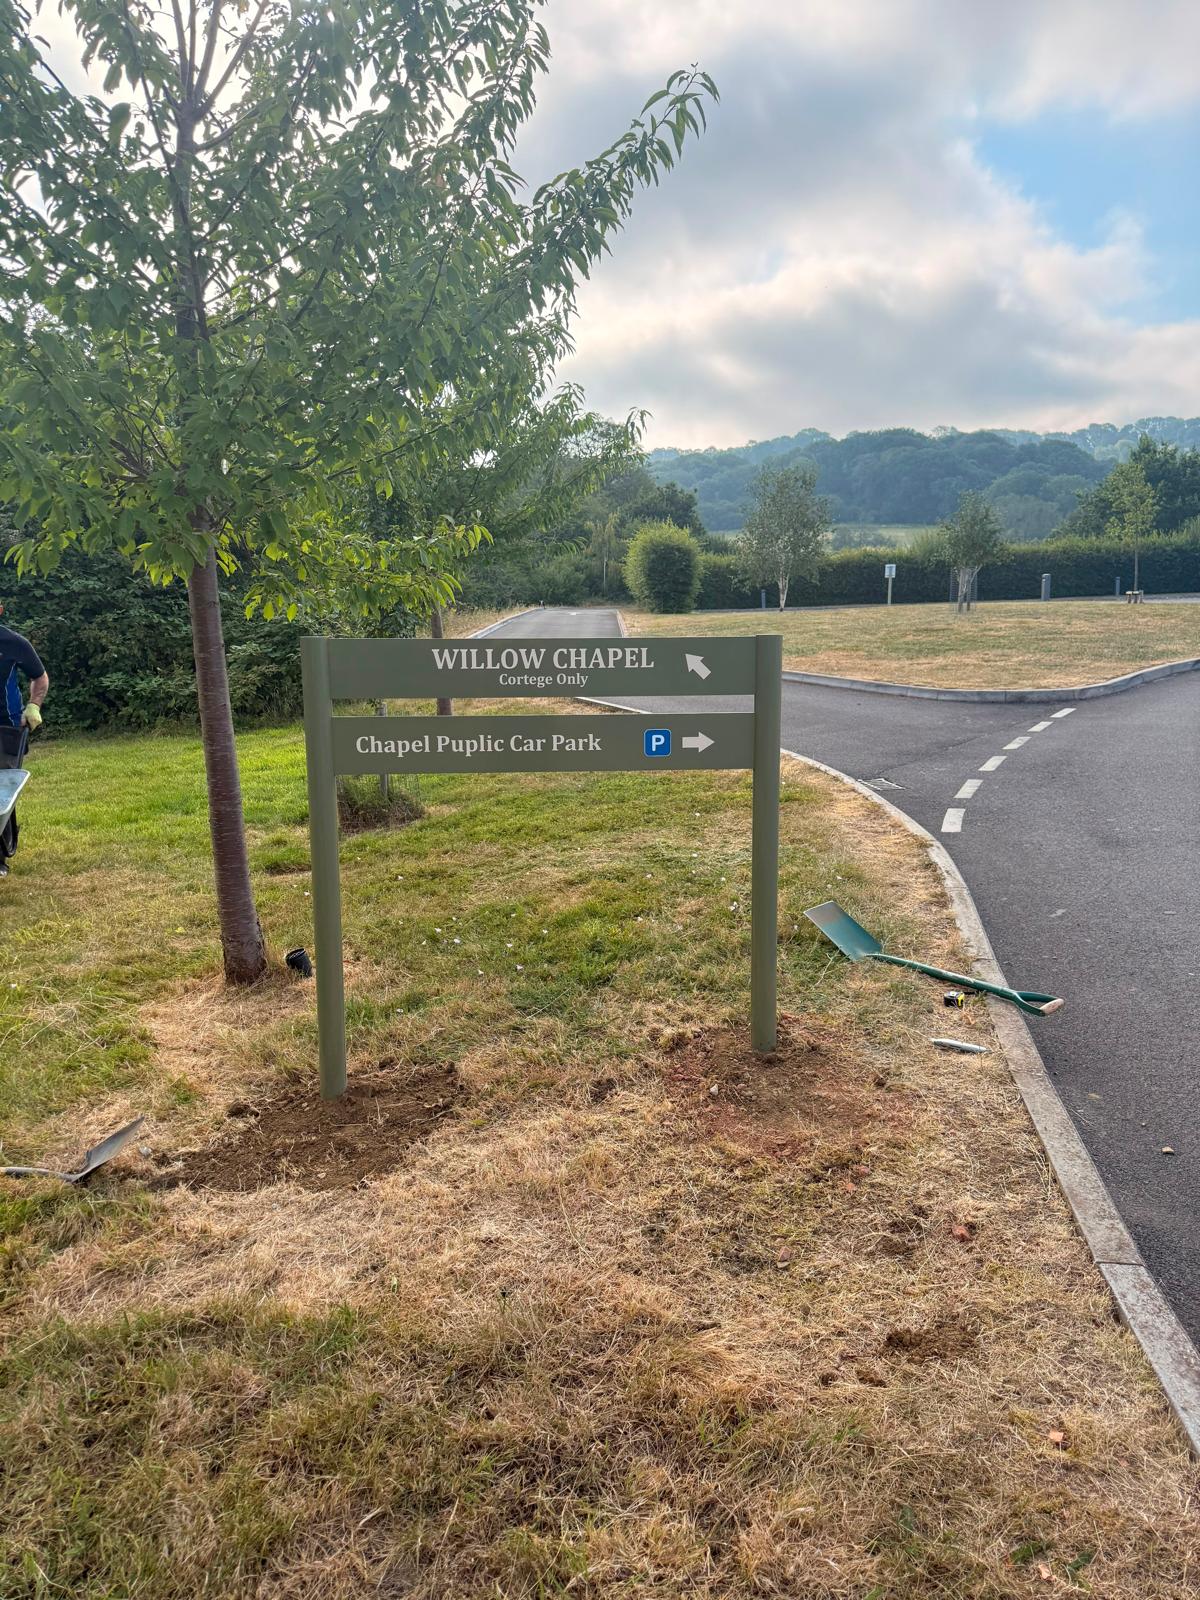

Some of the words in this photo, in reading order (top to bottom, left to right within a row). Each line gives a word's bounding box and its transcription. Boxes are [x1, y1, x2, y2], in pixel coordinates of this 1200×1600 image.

[431, 648, 547, 670] WILLOW
[553, 647, 655, 669] CHAPEL
[499, 673, 553, 688] Cortege
[557, 672, 589, 688] Only
[356, 735, 431, 758] Chapel
[436, 734, 504, 757] Puplic
[510, 734, 546, 752] Car
[552, 733, 602, 752] Park
[651, 734, 665, 752] P
